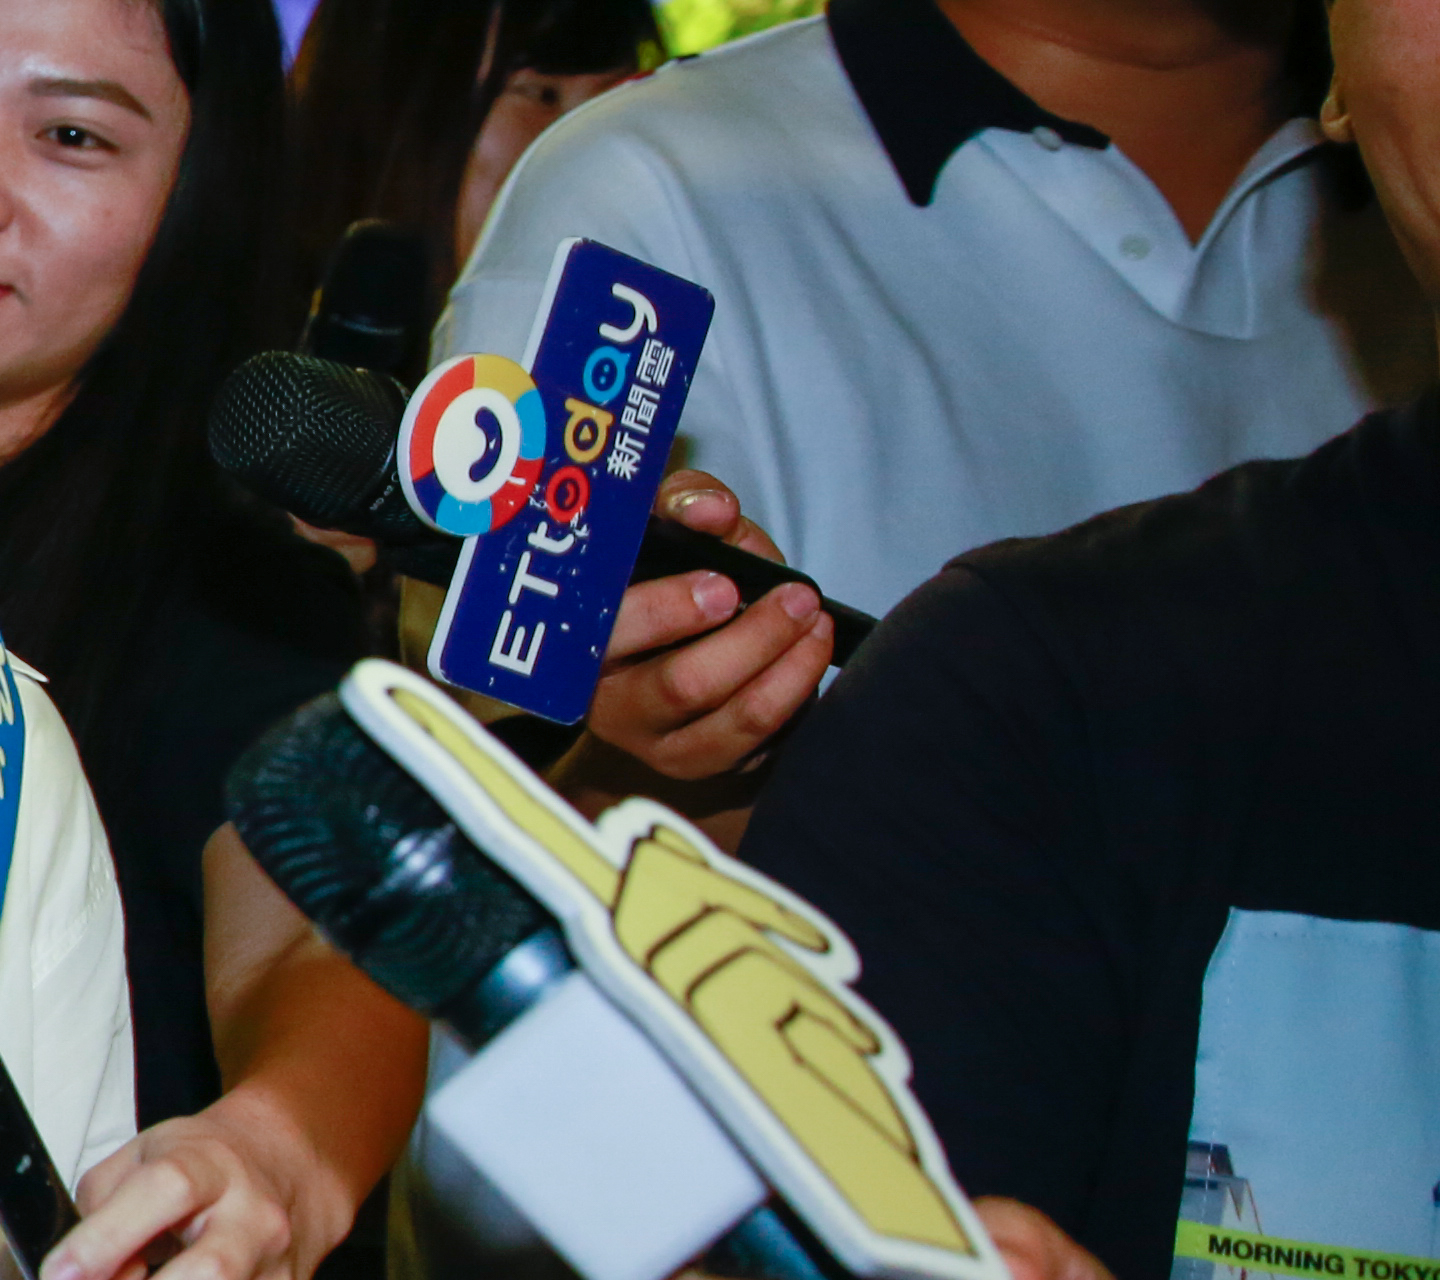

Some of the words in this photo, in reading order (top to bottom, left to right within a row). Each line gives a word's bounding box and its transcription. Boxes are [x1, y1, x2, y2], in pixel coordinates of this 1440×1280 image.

[488, 281, 660, 678] ETtoday
[606, 337, 676, 481] 新聞雲
[1208, 1234, 1345, 1275] MORNING
